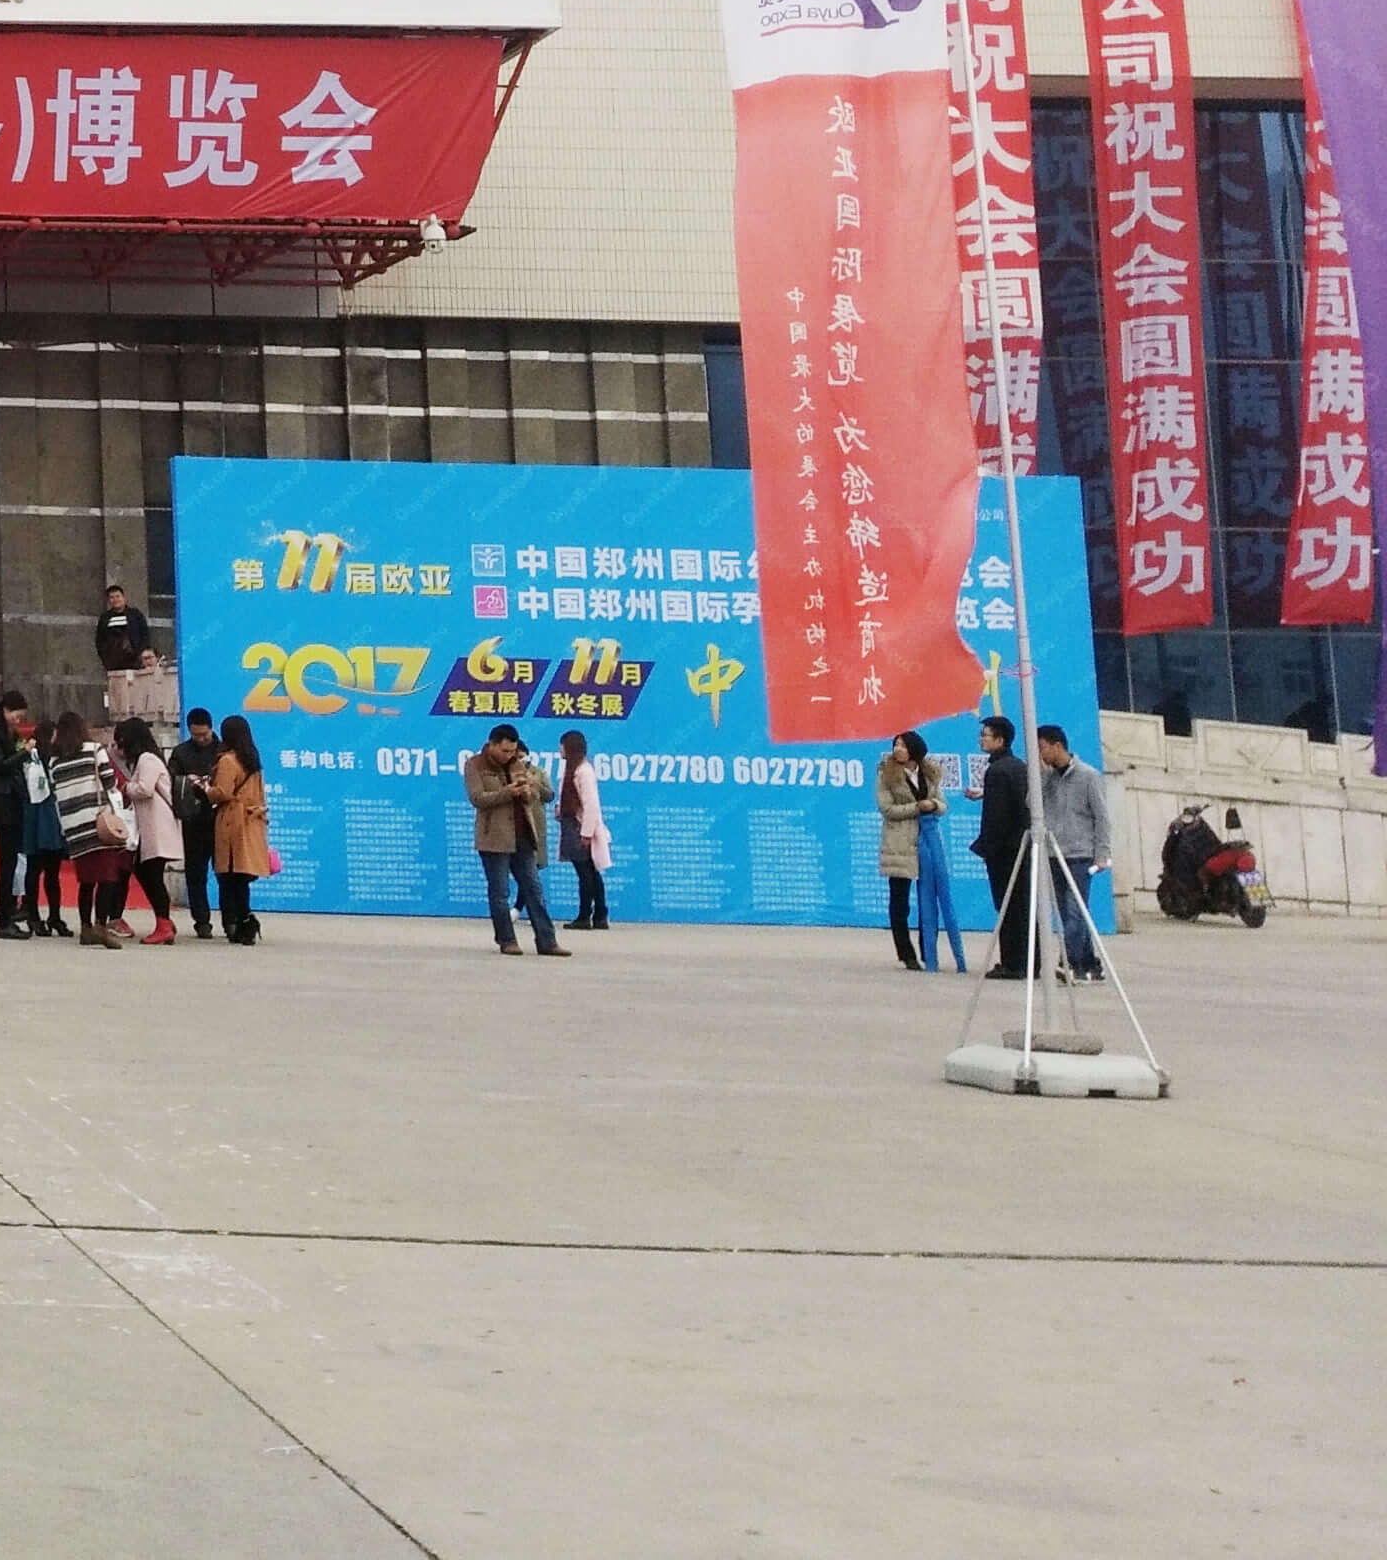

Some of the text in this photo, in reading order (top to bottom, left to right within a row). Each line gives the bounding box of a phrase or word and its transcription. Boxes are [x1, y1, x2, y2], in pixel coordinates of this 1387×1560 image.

[241, 643, 430, 714] 2017
[448, 690, 520, 714] 春夏展
[551, 693, 624, 717] 秋冬展
[594, 752, 724, 785] 60272780
[733, 754, 864, 788] 60272790
